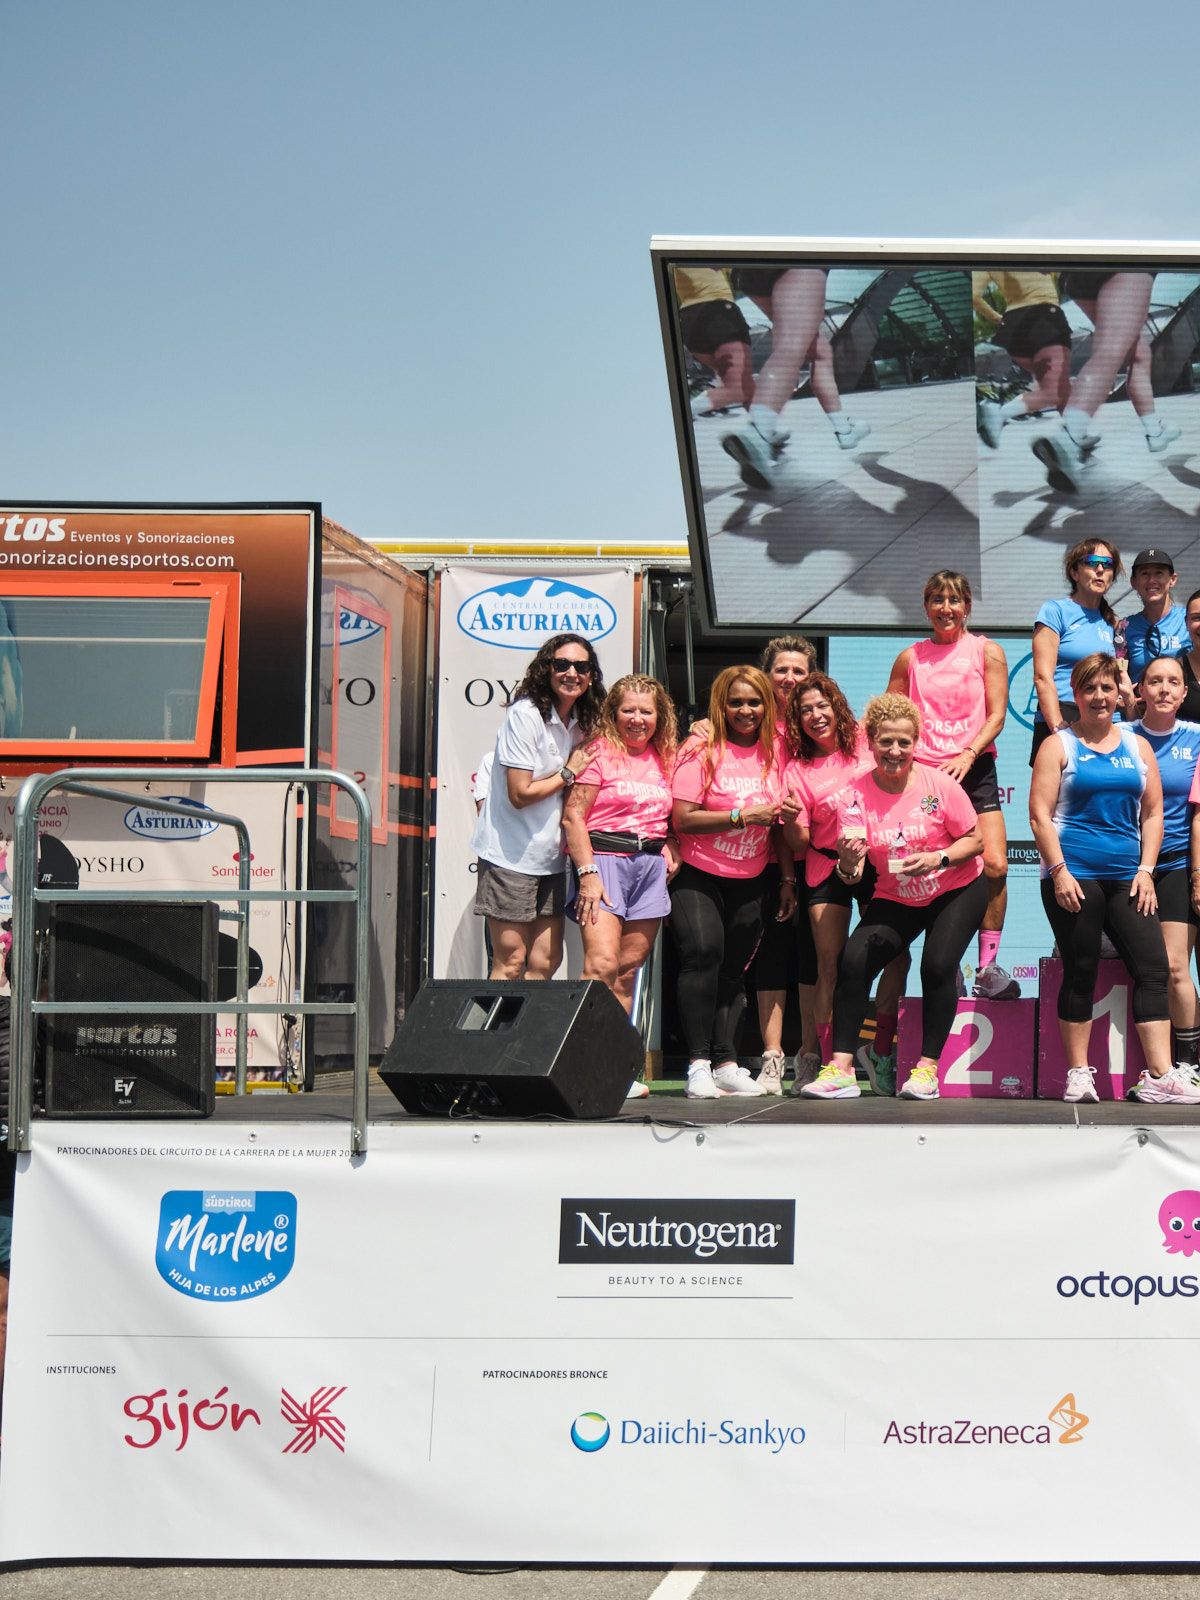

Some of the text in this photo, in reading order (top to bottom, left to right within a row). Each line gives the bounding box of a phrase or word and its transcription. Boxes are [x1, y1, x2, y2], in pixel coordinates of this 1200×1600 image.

[0, 514, 235, 544] tos Eventos y Sonorizaciones
[550, 602, 599, 610] LECHERA
[469, 604, 605, 631] ASTURIANA
[721, 777, 773, 793] CARREA
[8, 806, 68, 815] VNCIA
[38, 820, 62, 828] UNIO
[131, 811, 213, 829] ASTURIANA
[75, 857, 145, 874] YSHO
[212, 866, 275, 877] Santnder
[1013, 966, 1038, 978] COSMO
[77, 1025, 177, 1046] portos
[1092, 985, 1127, 1074] 1
[944, 1011, 994, 1084] 2
[114, 1079, 135, 1097] EV
[57, 1147, 138, 1155] PATROCINADORES
[140, 1147, 157, 1155] DEL
[160, 1148, 203, 1156] CIRCUITO
[205, 1148, 217, 1156] DE
[277, 1149, 290, 1157] DE
[292, 1149, 304, 1157] LA
[306, 1149, 337, 1157] MUJER
[575, 1211, 780, 1257] Neutrogena
[168, 1268, 277, 1297] HIJA DE LOS ALPES
[608, 1276, 743, 1286] BEAUTY TO A SCIENCE
[1056, 1270, 1200, 1305] octopus
[46, 1366, 117, 1375] INSTITUCIONES
[482, 1370, 608, 1379] PATROCINADORES BRONCE
[123, 1386, 261, 1452] gijón
[620, 1419, 806, 1453] Daiichi-Sankyo
[883, 1420, 1051, 1445] AstraZeneca
